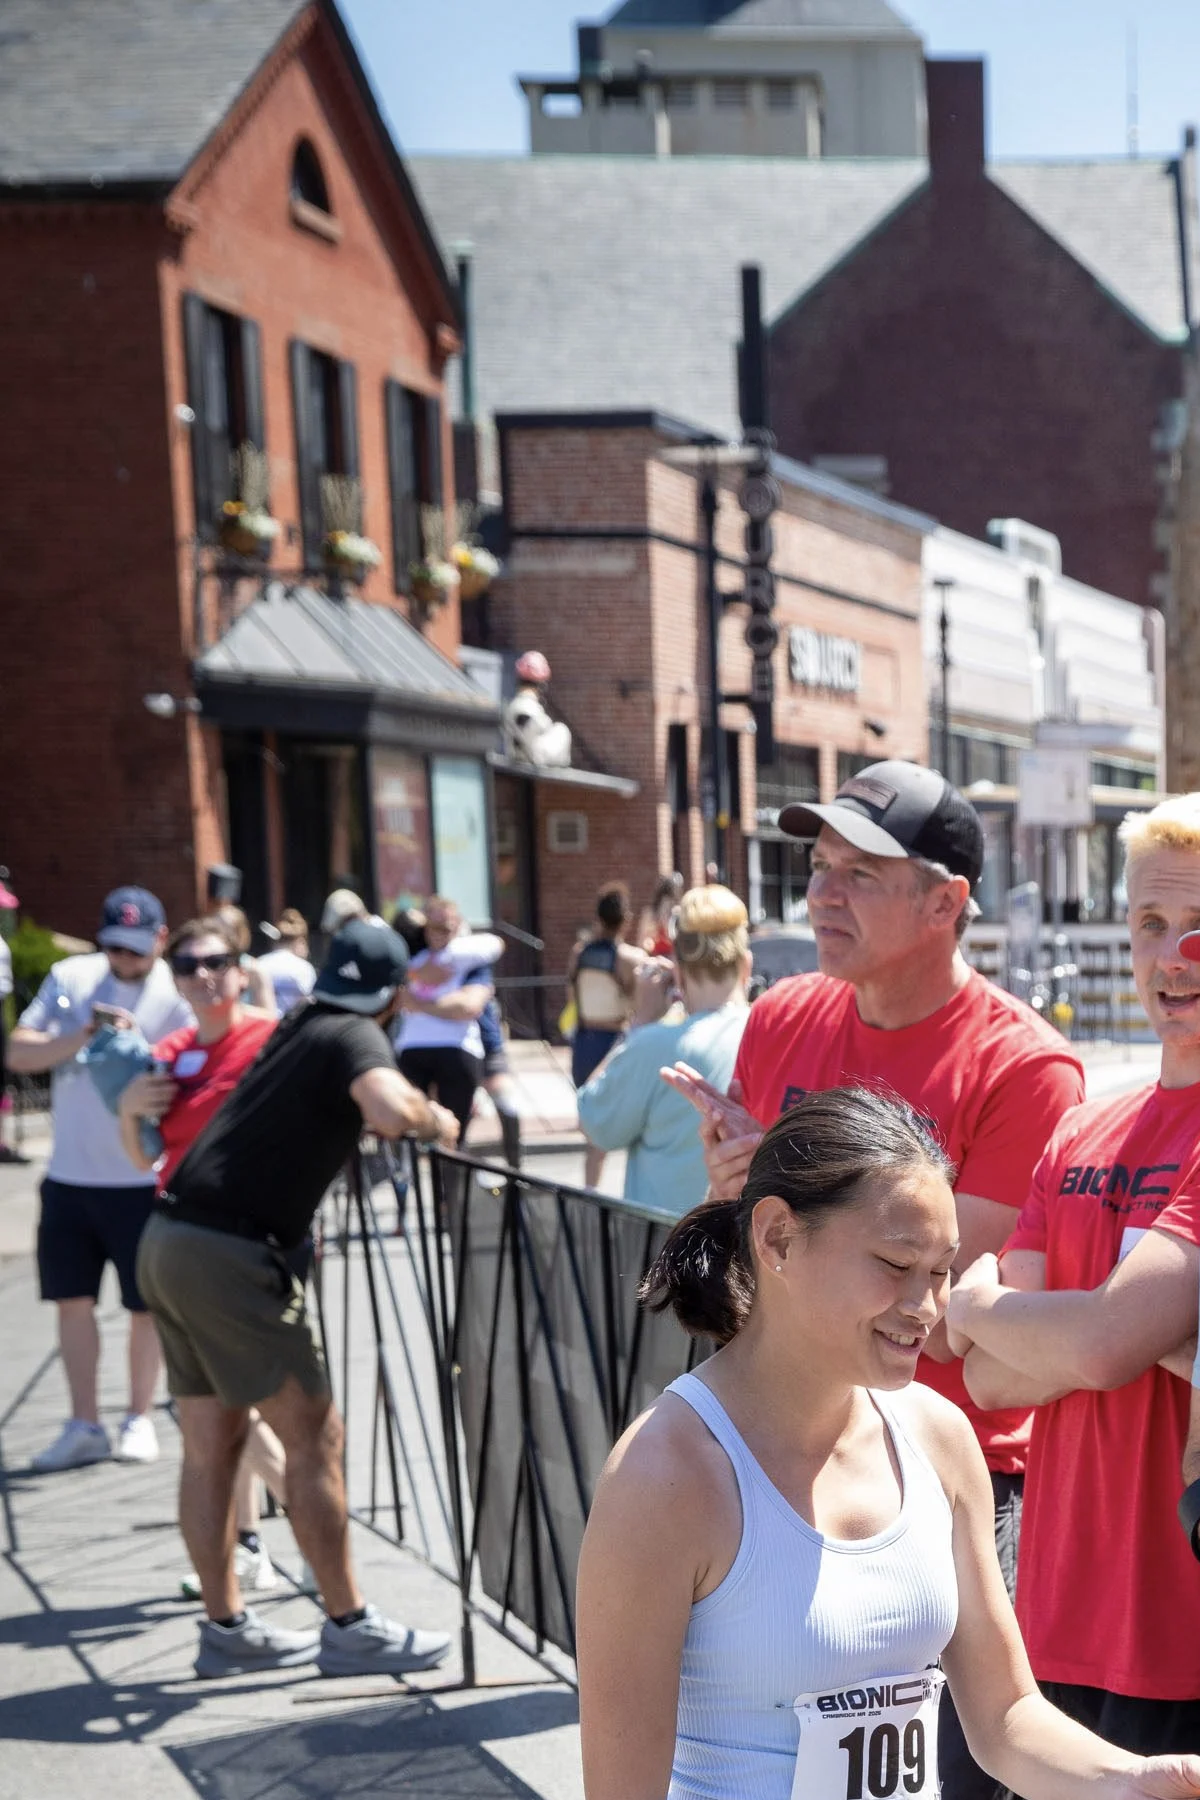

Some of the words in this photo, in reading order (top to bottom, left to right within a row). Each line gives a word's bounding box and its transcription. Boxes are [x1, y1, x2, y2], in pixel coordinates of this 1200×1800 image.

[817, 1679, 922, 1712] BIONIC
[822, 1712, 855, 1720] CAMBRIDGE
[838, 1718, 925, 1800] 109
